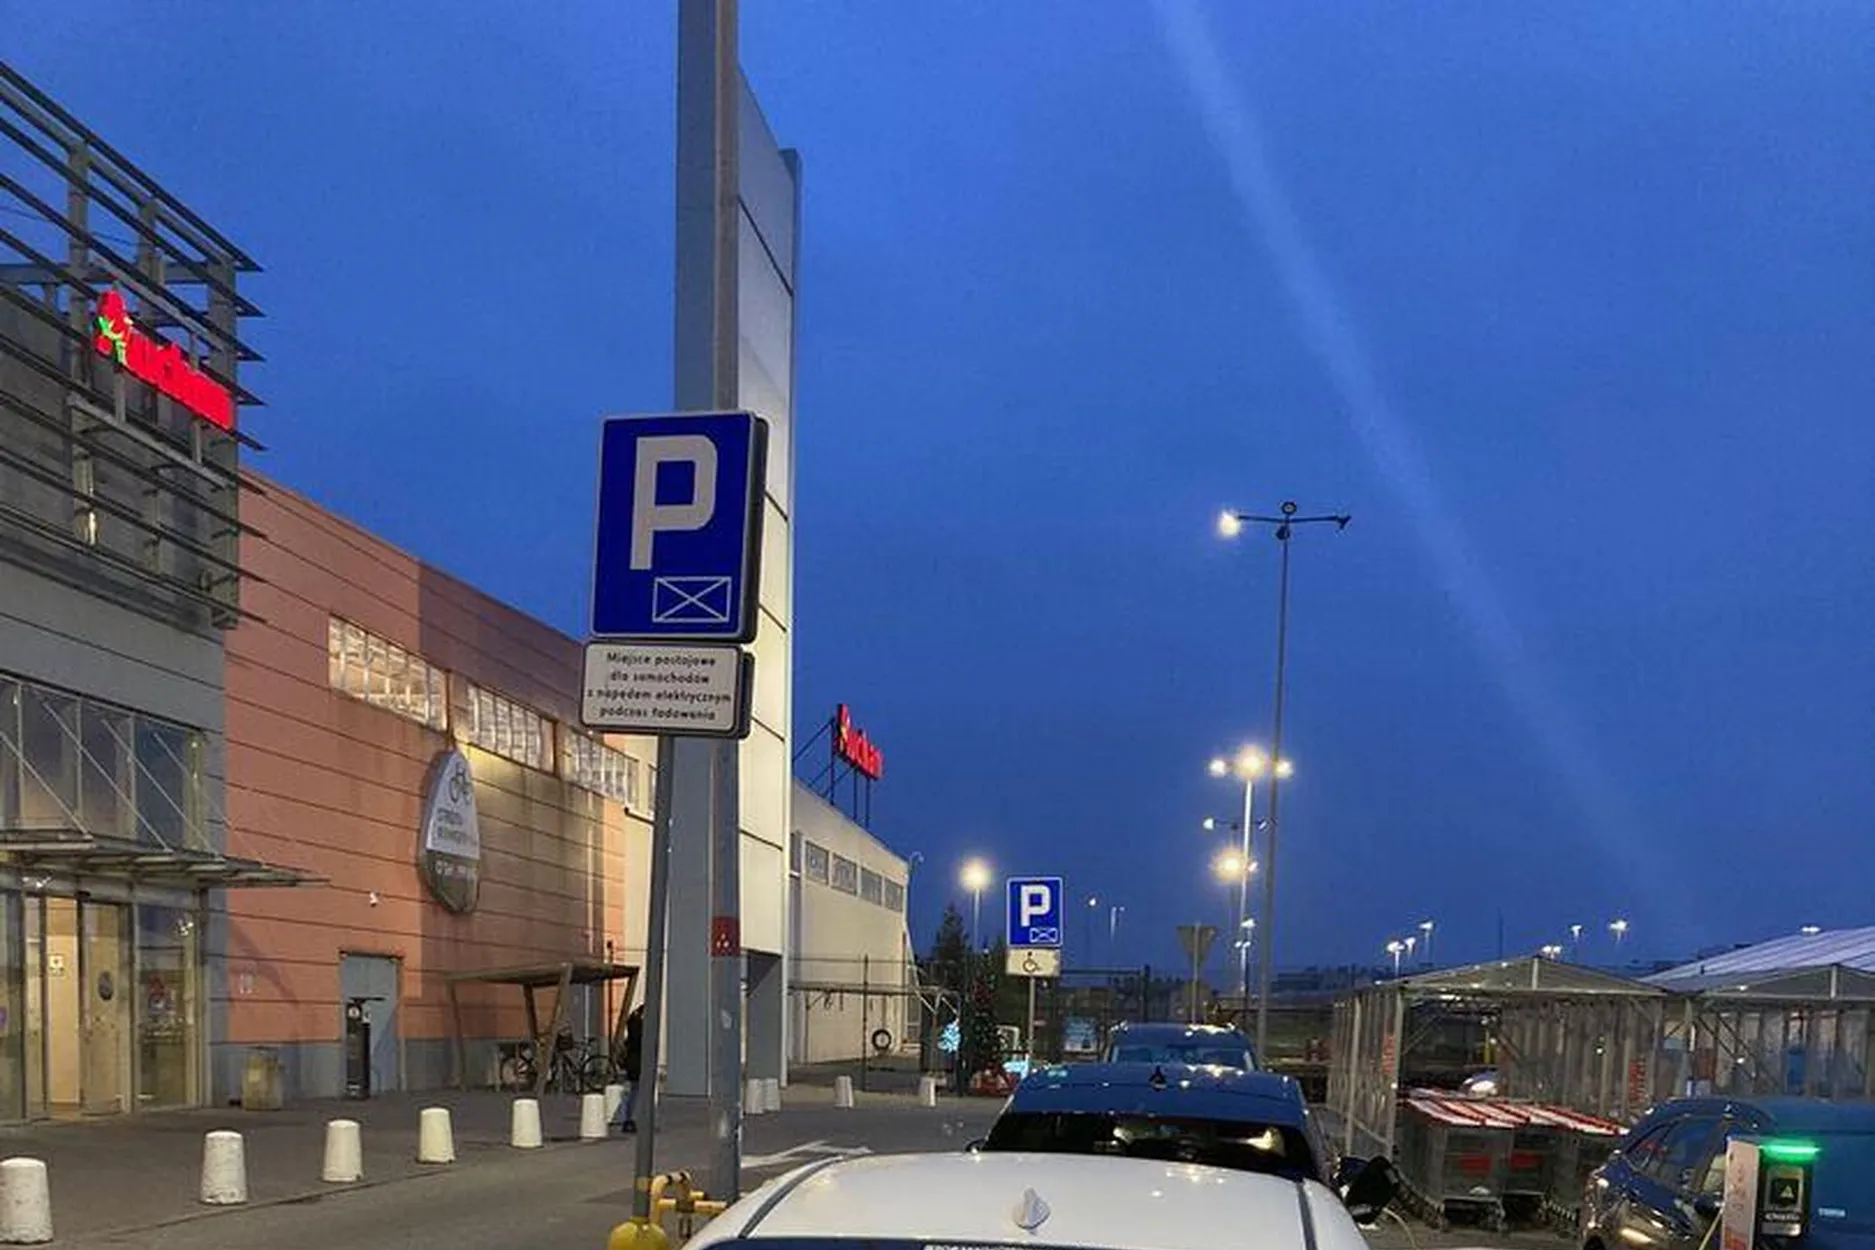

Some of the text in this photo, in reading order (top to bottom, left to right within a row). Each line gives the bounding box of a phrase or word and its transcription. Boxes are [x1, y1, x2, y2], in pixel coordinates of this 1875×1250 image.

[629, 434, 718, 570] P
[606, 652, 716, 669] Miejsce postojowe
[610, 671, 710, 685] dla samochodów
[655, 690, 731, 705] elektrycznym
[600, 706, 647, 718] podczas
[1020, 884, 1051, 927] P
